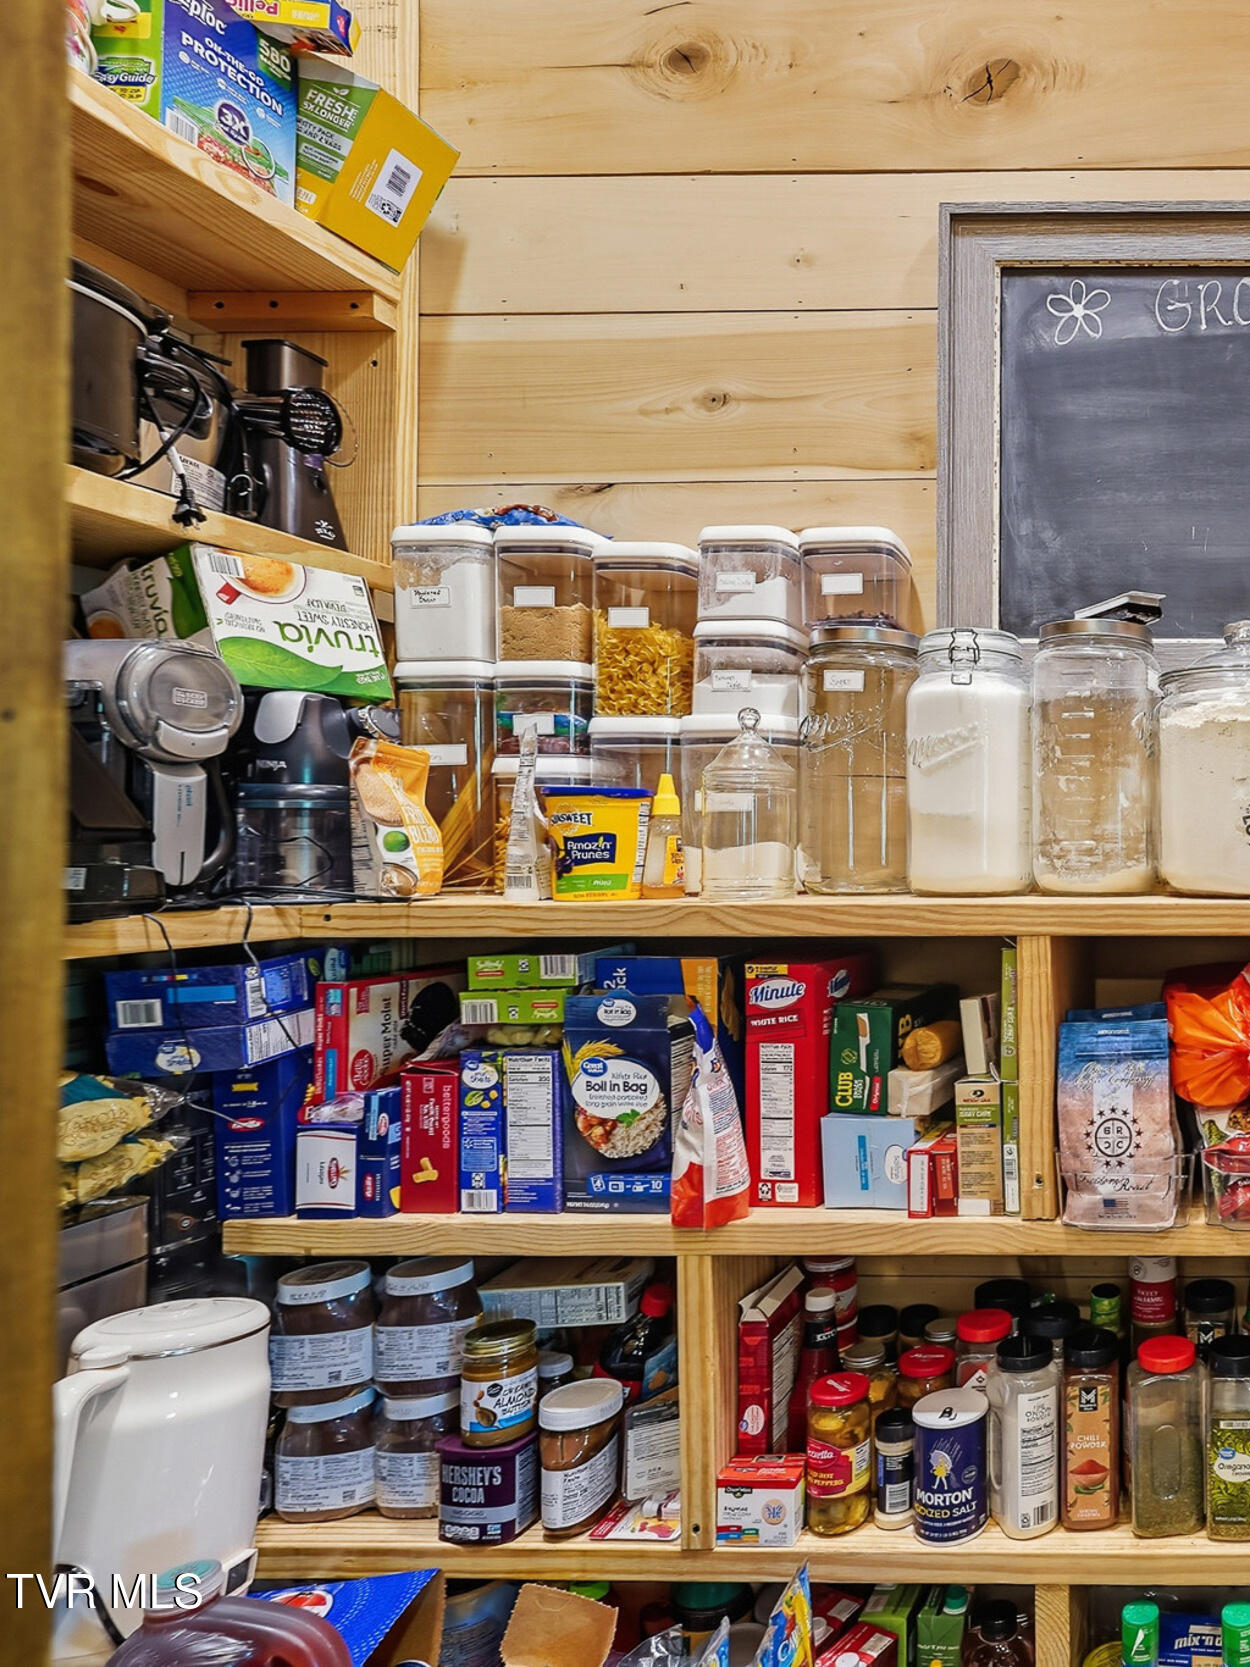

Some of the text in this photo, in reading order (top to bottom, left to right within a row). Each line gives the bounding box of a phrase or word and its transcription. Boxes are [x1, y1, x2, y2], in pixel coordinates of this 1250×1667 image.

[259, 38, 291, 73] 580
[180, 31, 284, 118] PROTECTION
[272, 620, 381, 659] truvia
[570, 849, 611, 861] Prunes
[749, 980, 806, 1005] Minute
[777, 1013, 799, 1024] RICE
[585, 1080, 648, 1096] Boil in Bag
[835, 1072, 853, 1107] CLUB
[442, 1465, 503, 1486] HERSHEY'S
[1217, 1462, 1250, 1474] Oregano
[452, 1486, 485, 1504] COCOA
[915, 1487, 975, 1507] MORTON
[952, 1500, 978, 1517] SALT
